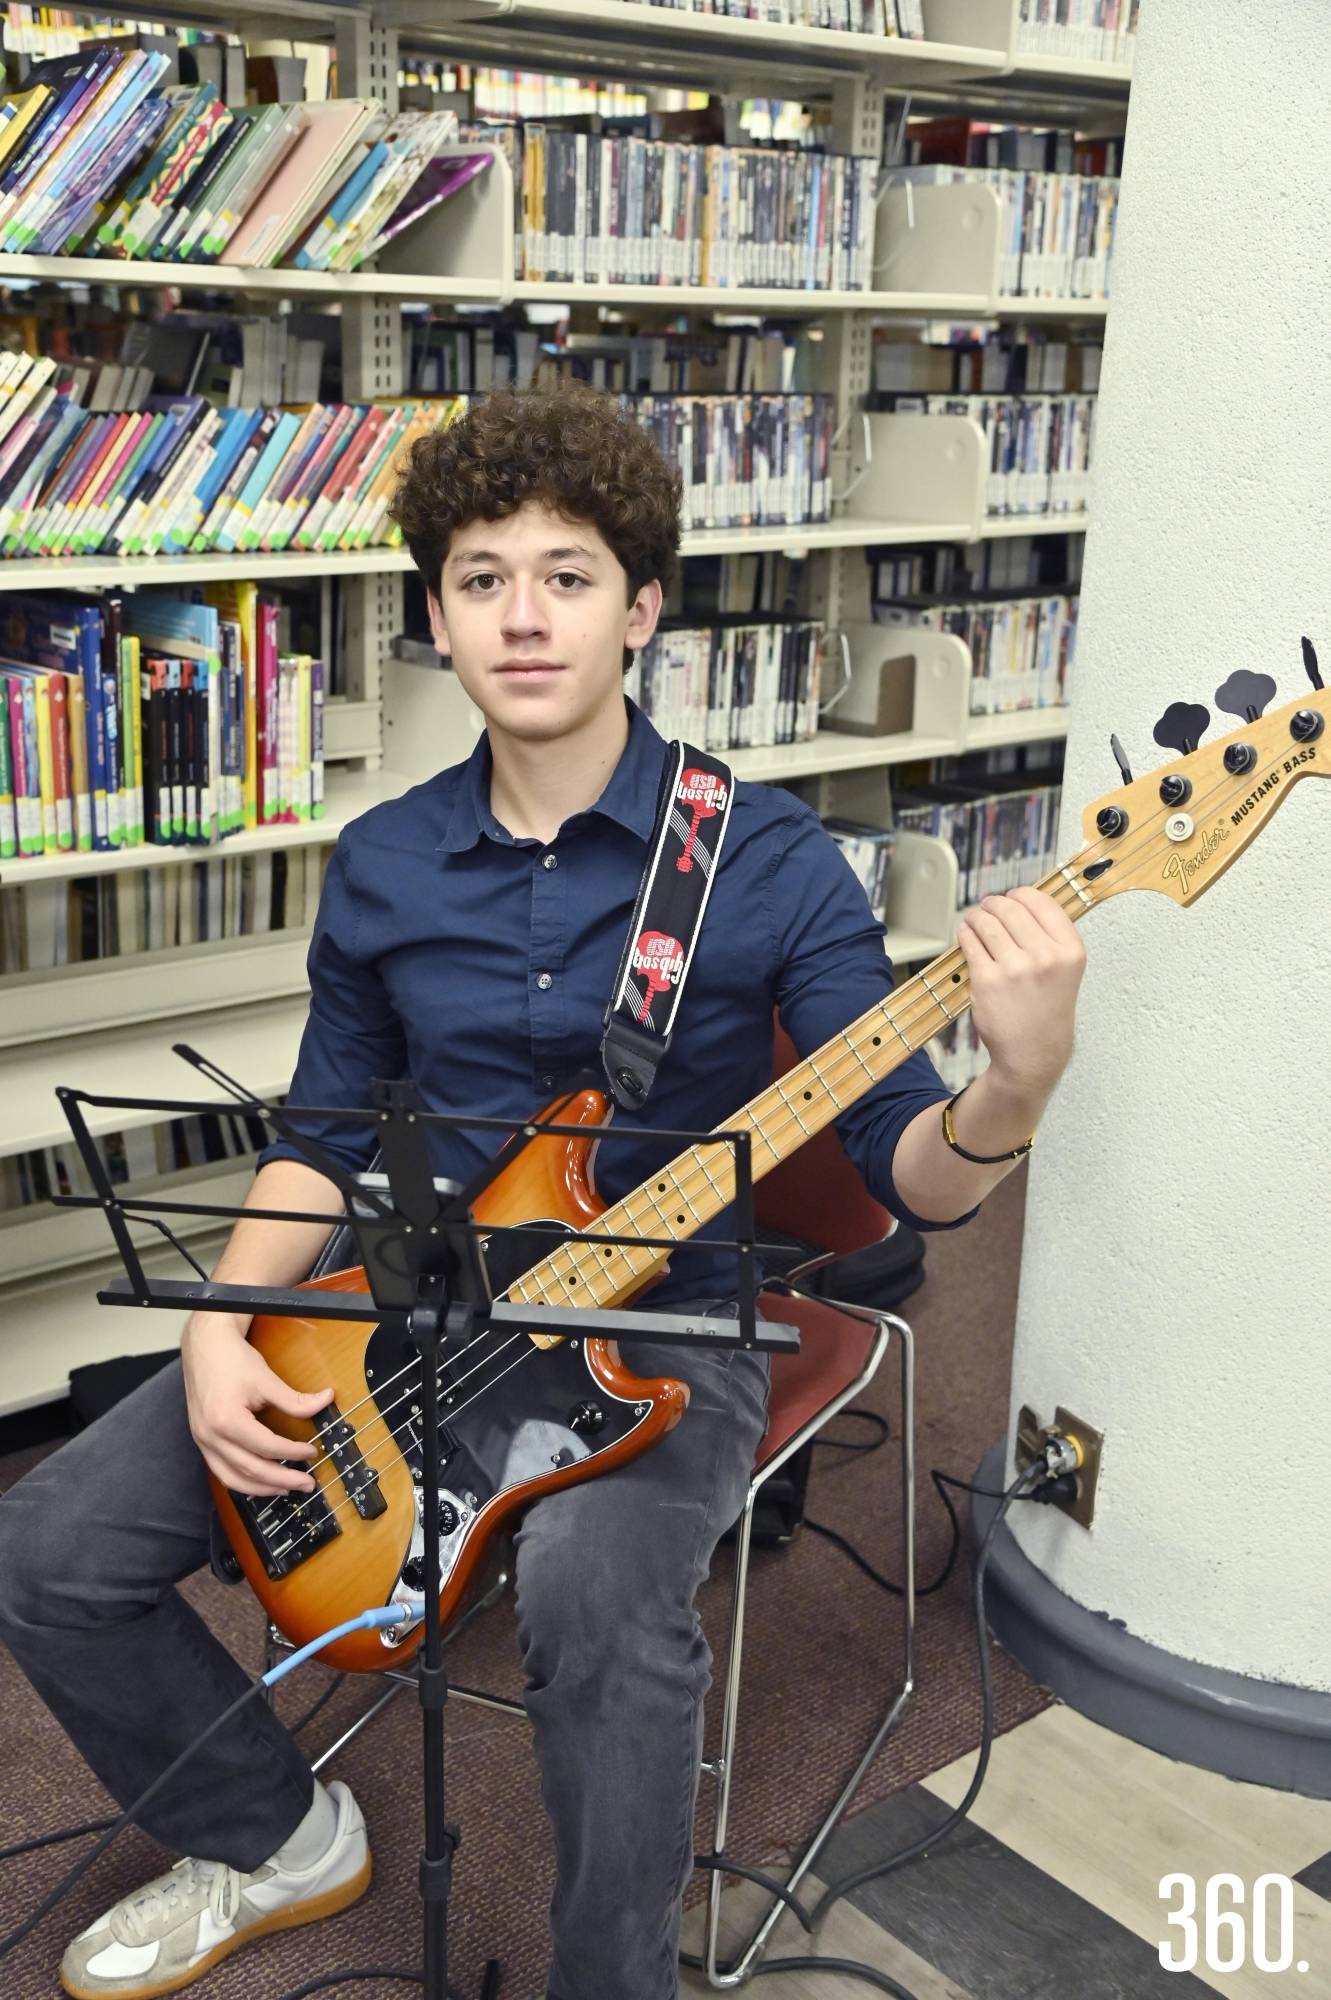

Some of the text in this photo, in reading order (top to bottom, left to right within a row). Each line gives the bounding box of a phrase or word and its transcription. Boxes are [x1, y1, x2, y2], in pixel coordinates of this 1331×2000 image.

[677, 782, 728, 811] Gibson
[690, 773, 717, 789] USA
[1230, 747, 1317, 826] MUSTANG BASS
[1162, 827, 1227, 895] Fender
[647, 937, 675, 957] USA
[633, 950, 684, 985] Gibson
